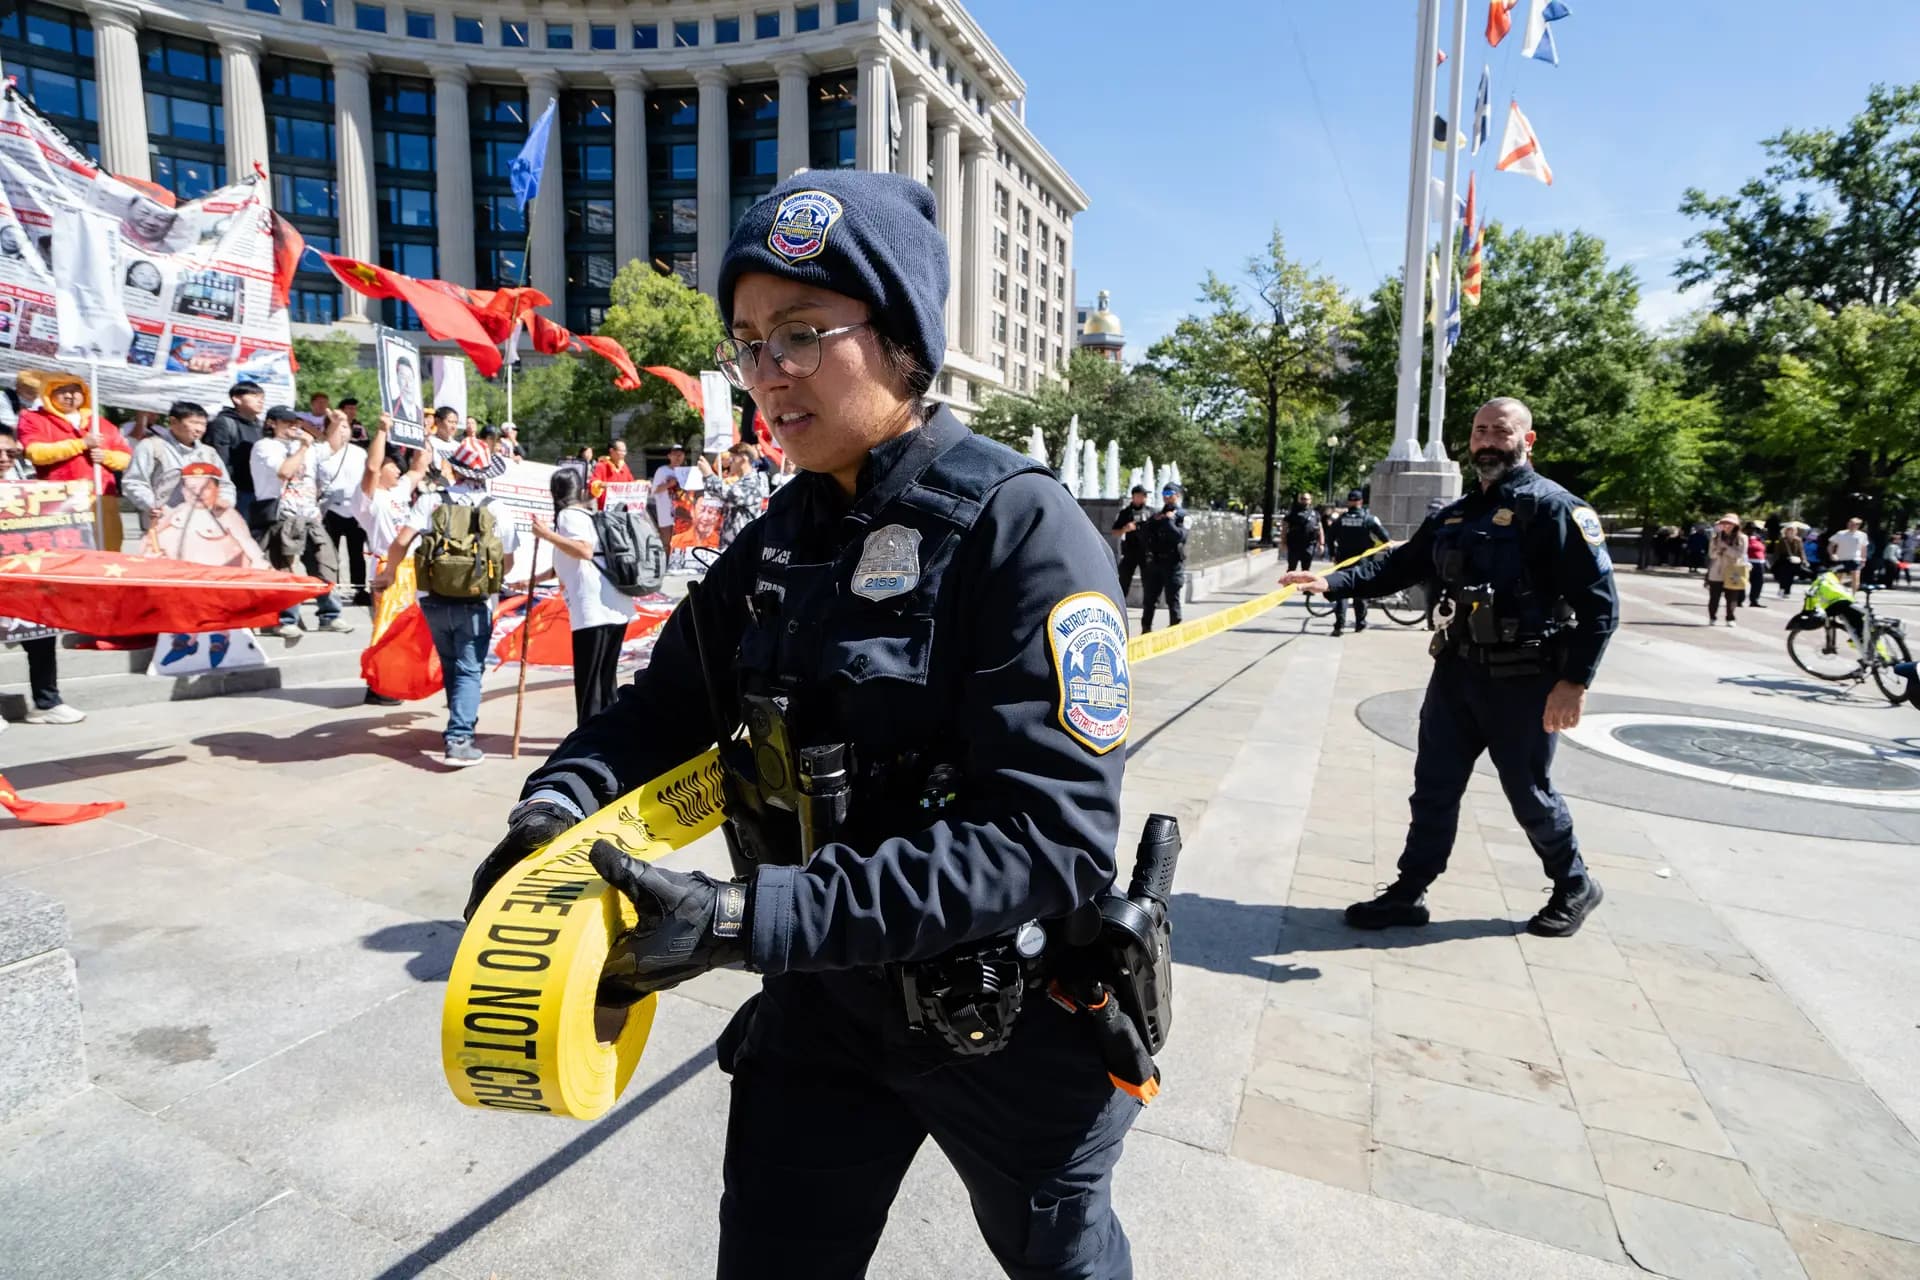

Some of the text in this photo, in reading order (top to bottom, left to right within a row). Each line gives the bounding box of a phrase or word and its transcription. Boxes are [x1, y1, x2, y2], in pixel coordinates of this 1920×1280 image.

[865, 577, 897, 588] 2159
[1056, 608, 1111, 638] METROPOLITAN
[1069, 706, 1099, 735] DISTRICT
[500, 868, 598, 916] LINE
[477, 924, 561, 972] DO
[464, 984, 542, 1060] NOT
